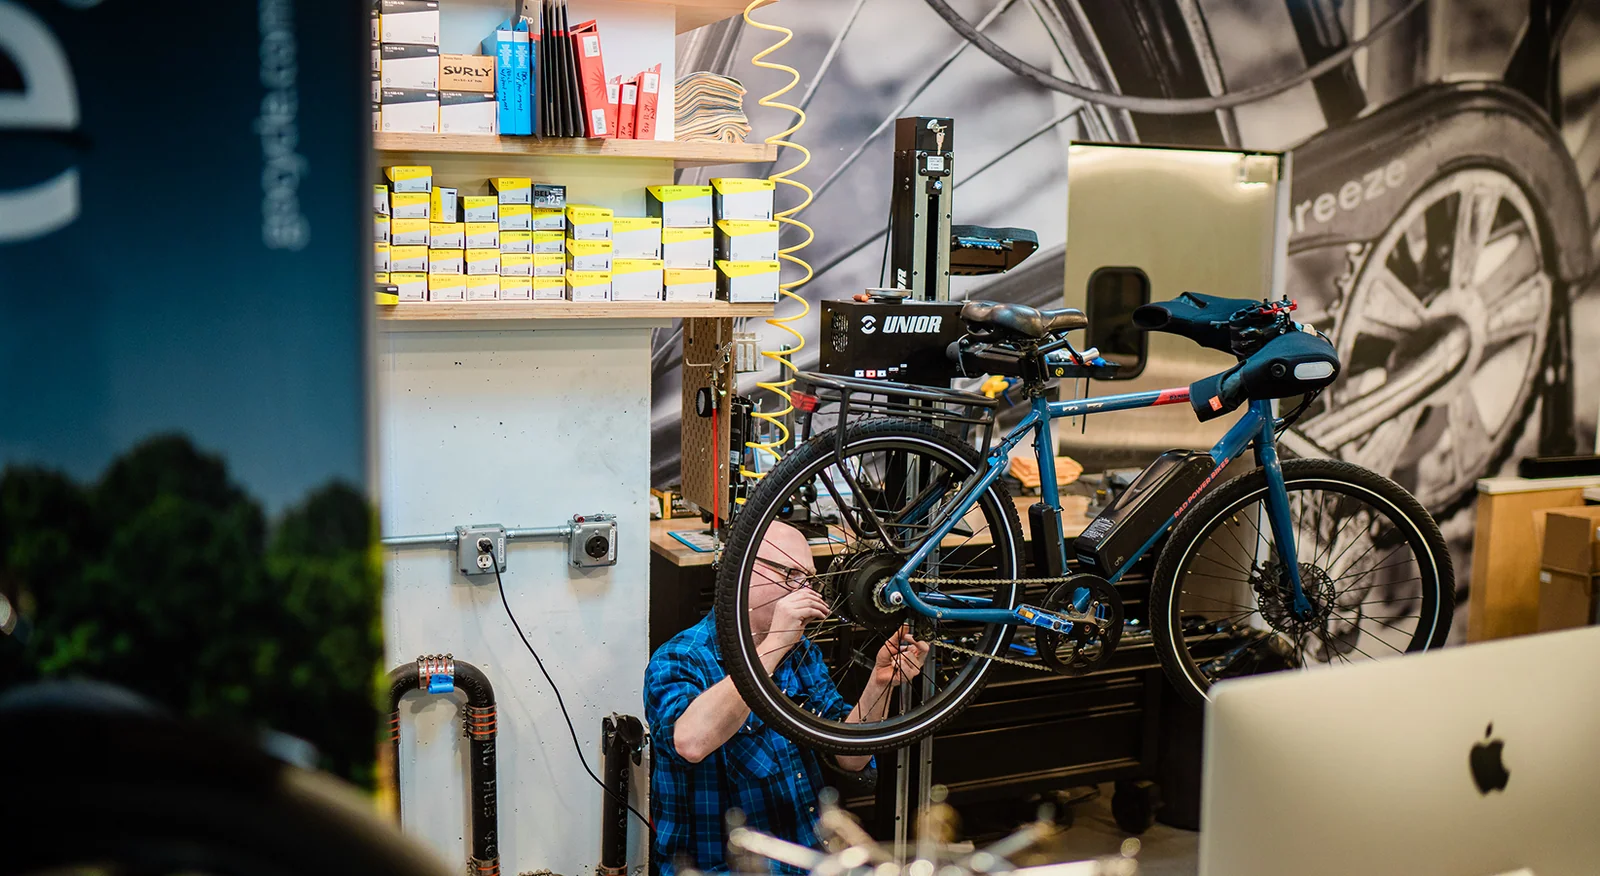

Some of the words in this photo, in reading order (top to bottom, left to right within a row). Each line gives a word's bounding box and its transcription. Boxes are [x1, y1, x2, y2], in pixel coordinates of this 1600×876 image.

[443, 65, 492, 77] SURLY
[1290, 159, 1408, 233] reeze
[882, 315, 943, 334] UNIOR
[1173, 502, 1188, 518] RAD
[1187, 478, 1211, 504] POWER
[1210, 457, 1230, 480] BIKES
